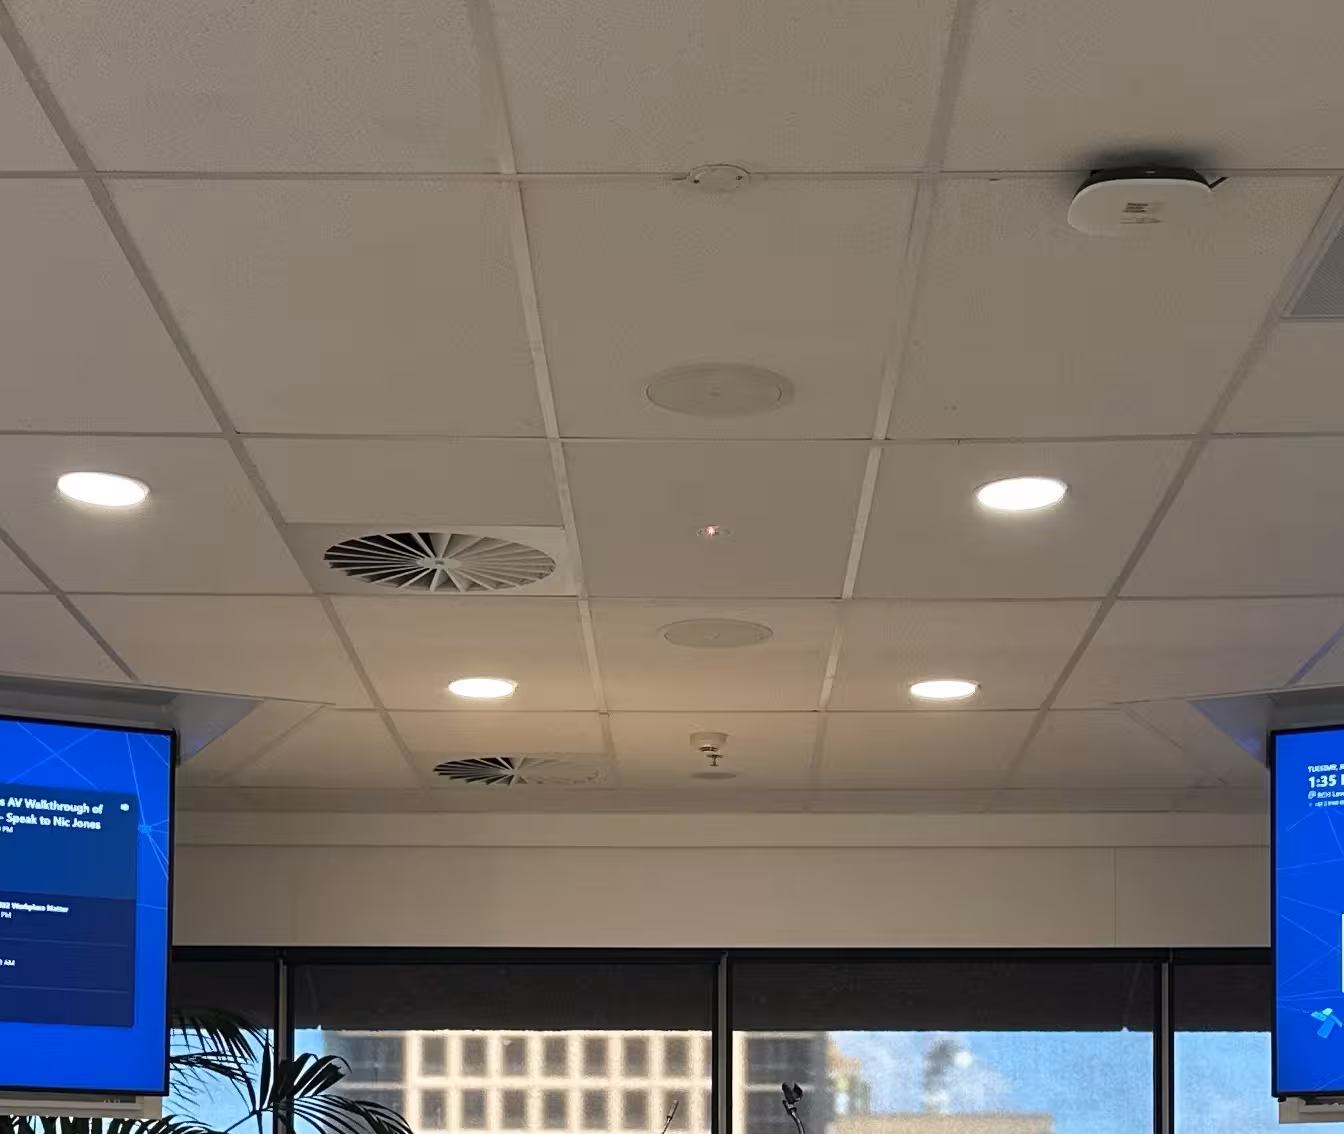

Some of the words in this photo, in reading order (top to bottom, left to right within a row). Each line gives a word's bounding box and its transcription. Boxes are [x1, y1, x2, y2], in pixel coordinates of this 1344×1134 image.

[1309, 775, 1337, 788] 1:35
[8, 798, 23, 808] AV
[25, 798, 89, 815] Walkthrough
[92, 804, 103, 814] of
[6, 812, 37, 825] Speak
[40, 816, 51, 826] to
[53, 817, 70, 827] Nic
[72, 818, 101, 830] Jones
